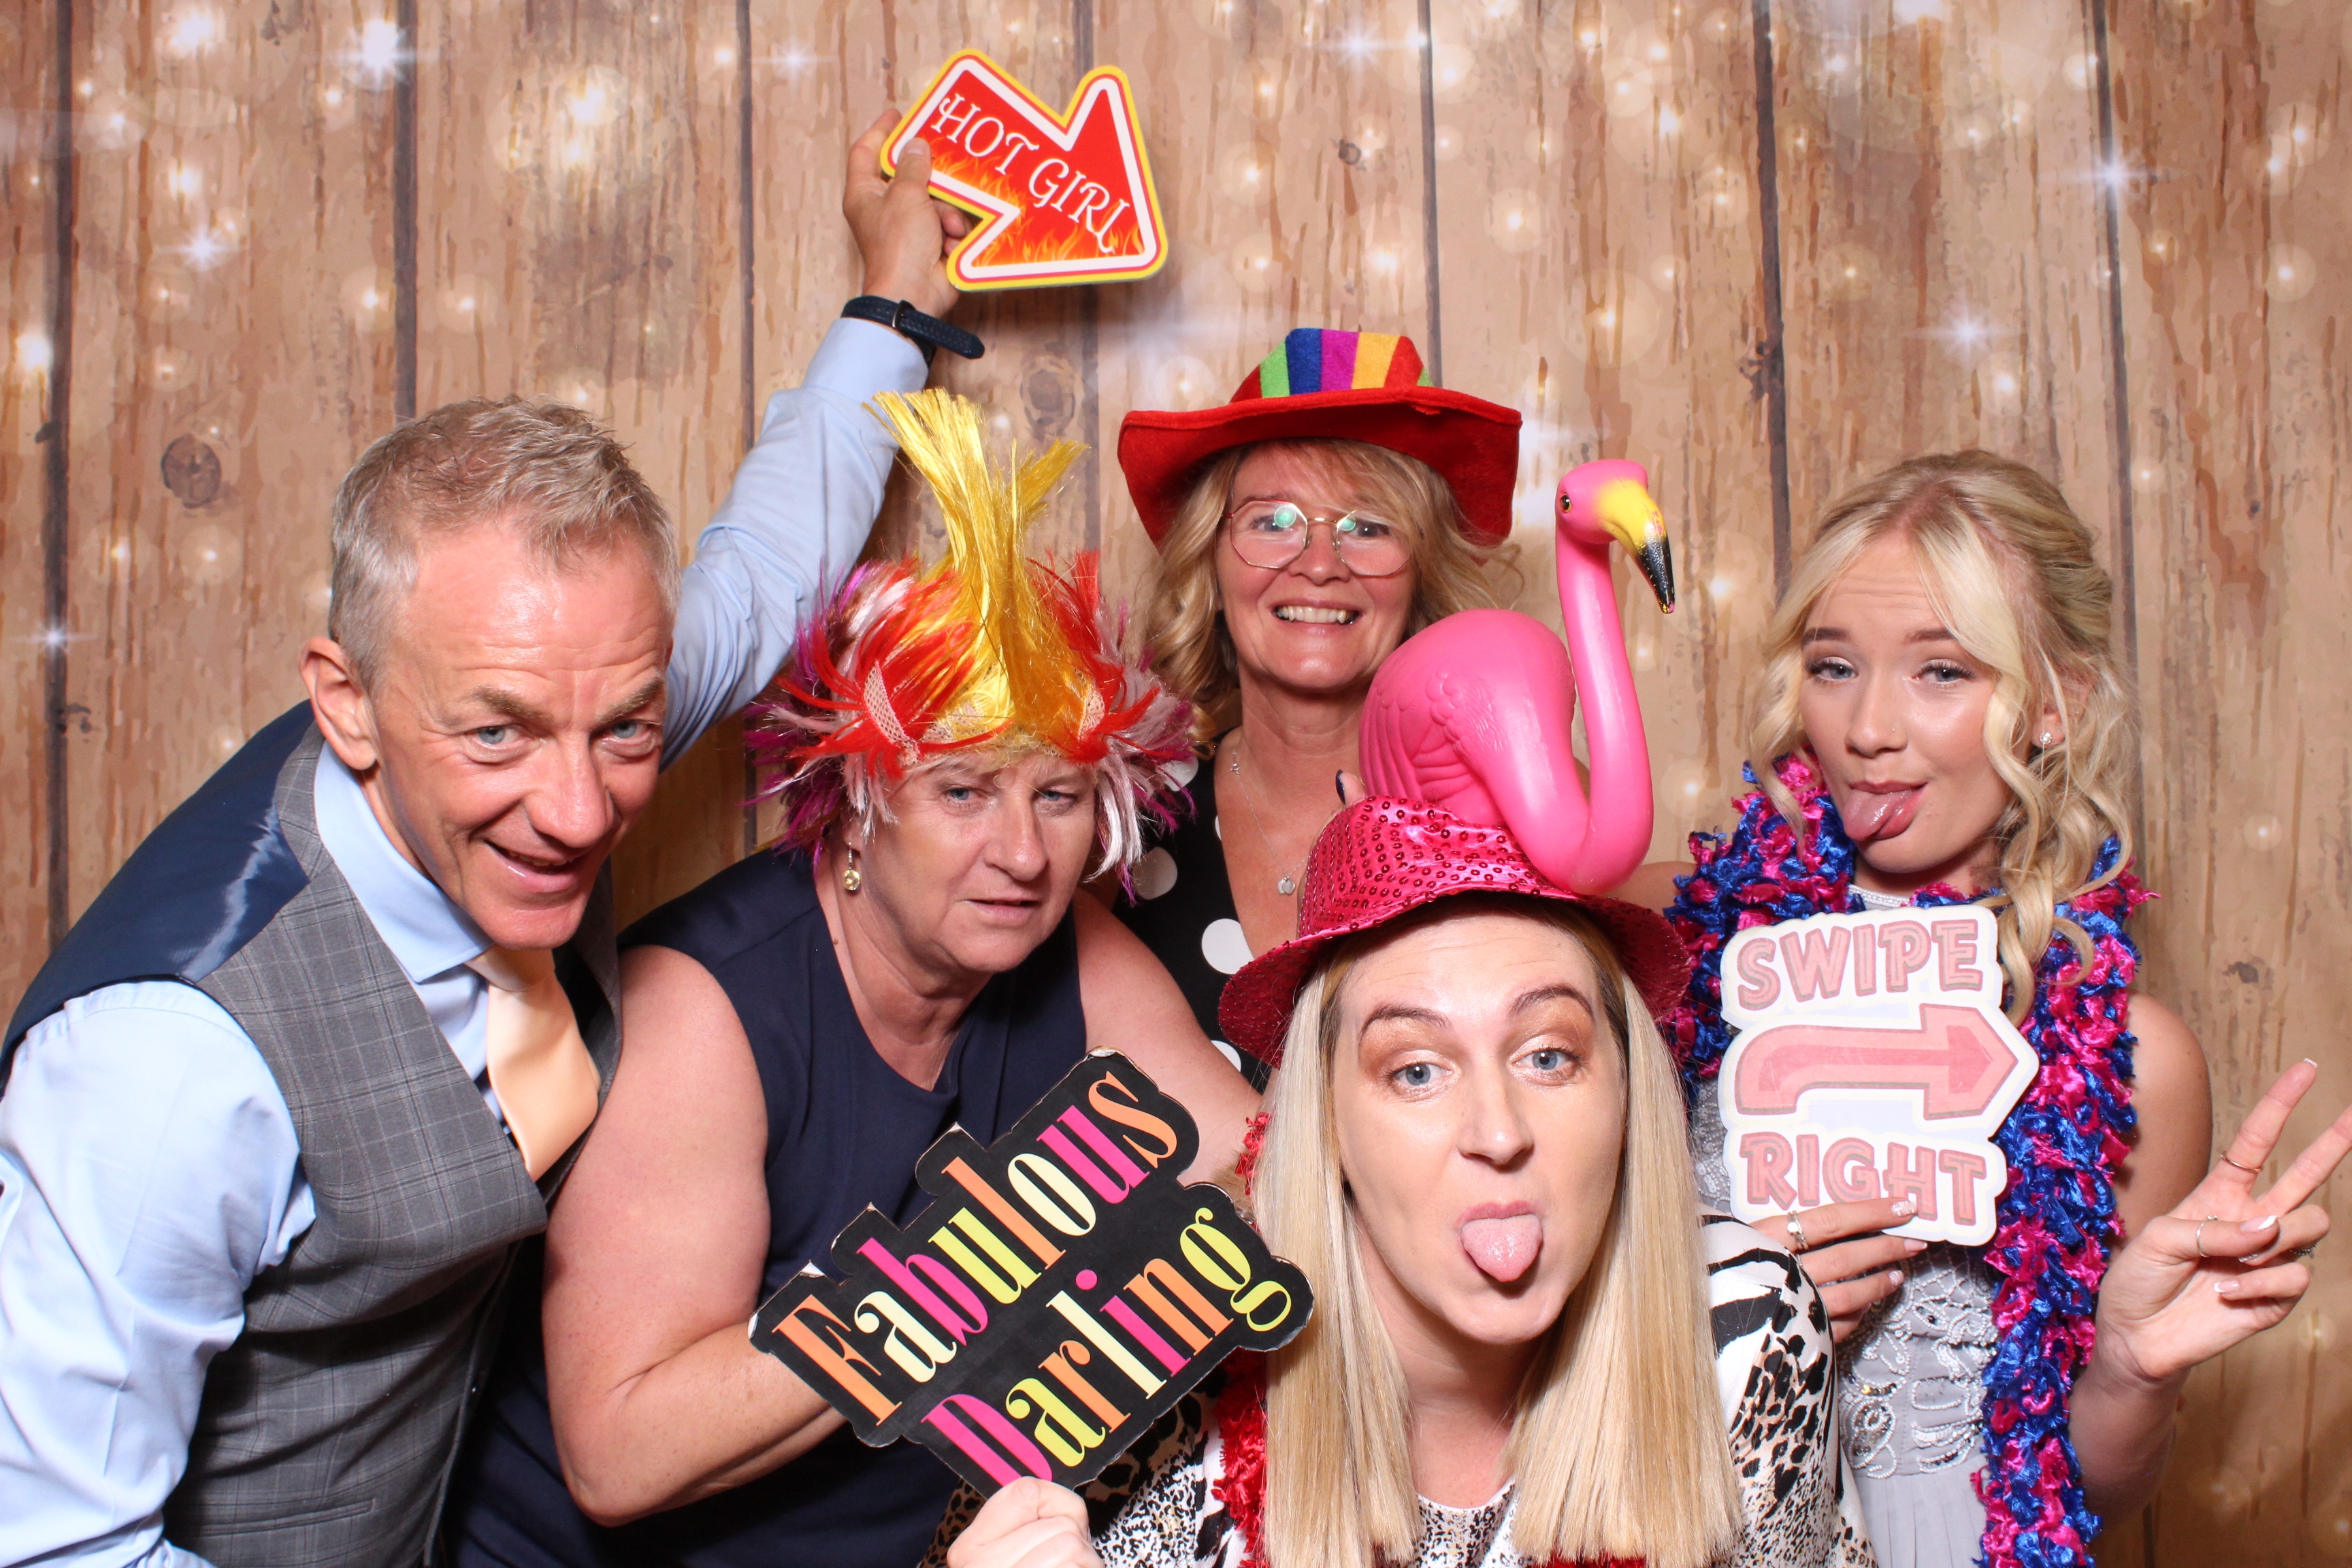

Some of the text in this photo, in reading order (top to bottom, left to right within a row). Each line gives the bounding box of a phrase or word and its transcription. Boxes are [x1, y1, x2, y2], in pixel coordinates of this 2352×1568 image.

[931, 93, 1130, 254] HOT GIRL
[1737, 919, 1983, 1011] SWIPE
[772, 1071, 1177, 1426] Fabulous
[1740, 1132, 1986, 1225] RIGHT
[921, 1207, 1292, 1486] Darling
